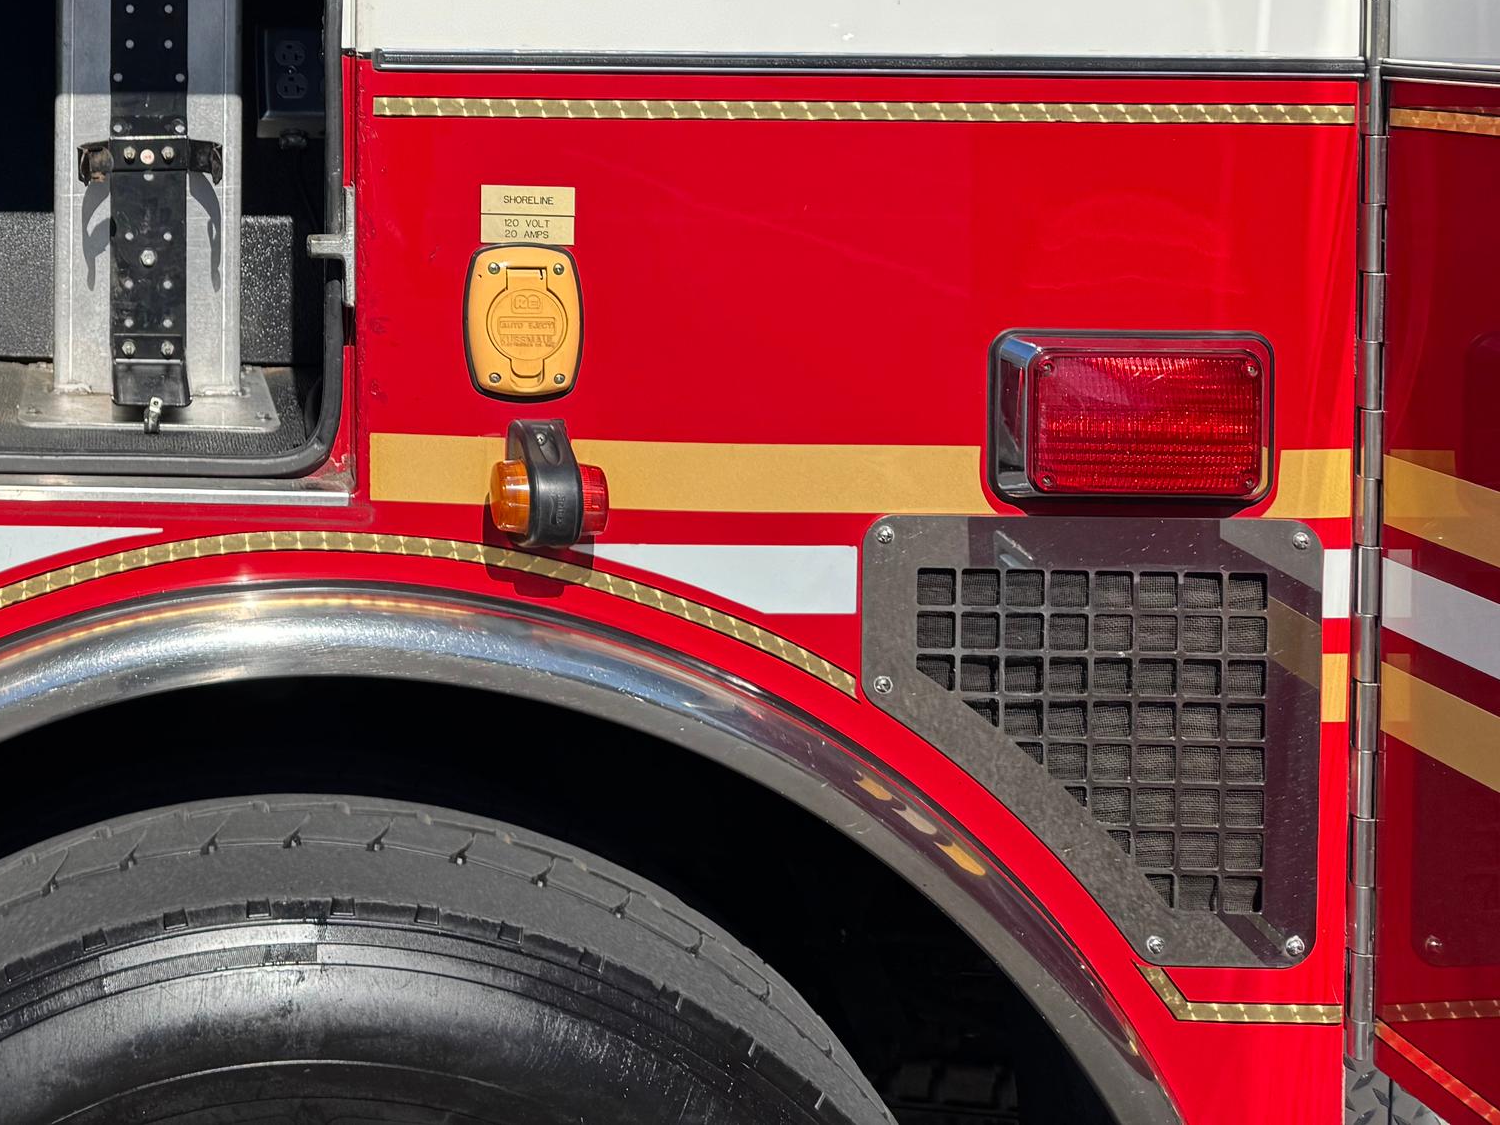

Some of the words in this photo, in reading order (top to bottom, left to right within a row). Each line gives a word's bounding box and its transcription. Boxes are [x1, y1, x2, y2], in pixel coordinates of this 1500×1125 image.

[503, 195, 554, 205] SHORELINE
[504, 218, 519, 227] 120
[525, 219, 550, 228] VOLT
[504, 229, 517, 238] 20
[523, 230, 549, 239] AMPS
